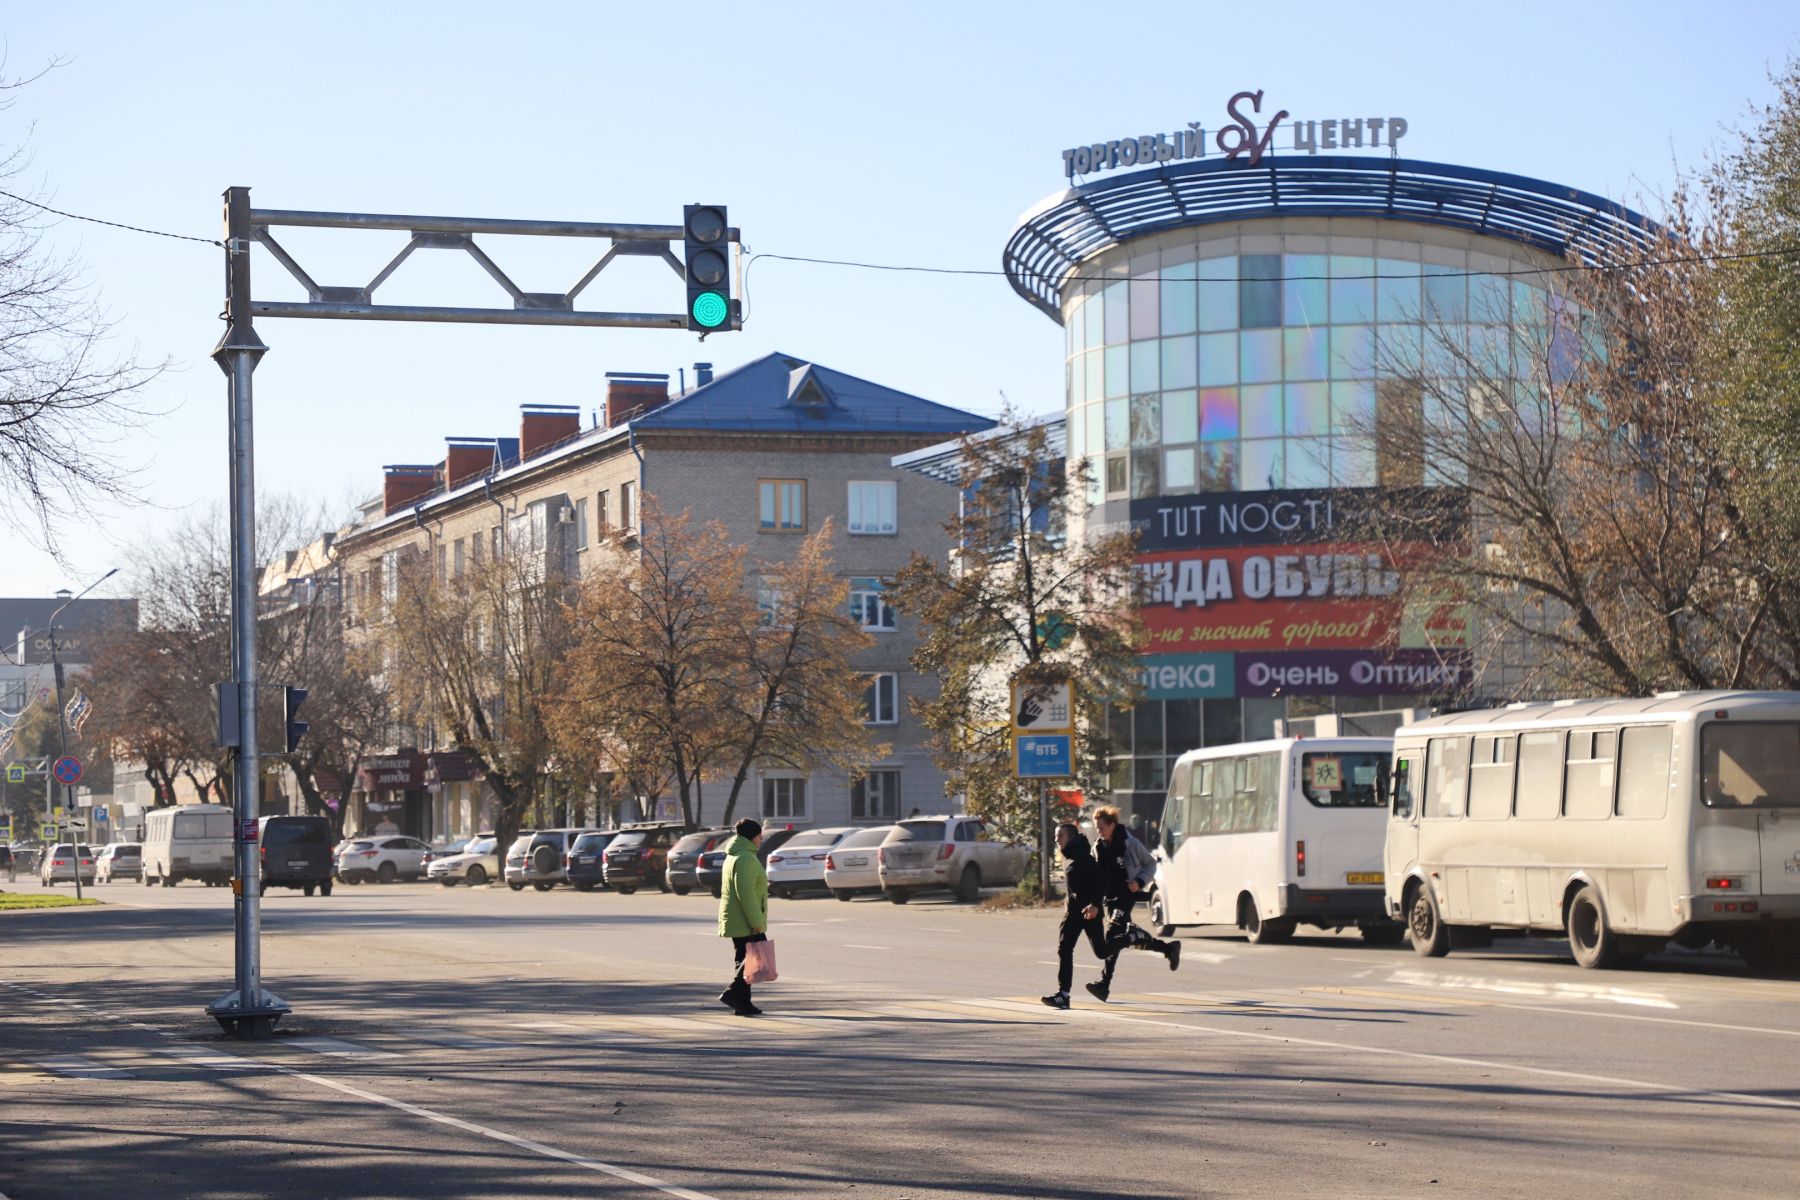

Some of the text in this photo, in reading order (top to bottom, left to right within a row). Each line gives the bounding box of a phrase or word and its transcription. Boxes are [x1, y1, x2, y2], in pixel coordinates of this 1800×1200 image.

[1062, 121, 1205, 178] ТОРГОВЫЙ
[1294, 117, 1408, 154] ЦЕНТР
[1158, 505, 1207, 537] TUT
[1220, 500, 1332, 534] NOGTI
[1242, 554, 1400, 599] ОБУВЬ
[1189, 619, 1274, 641] значит
[1282, 611, 1375, 646] дорого!
[1247, 660, 1460, 687] Очень Оптика
[1036, 744, 1058, 756] ВТБ
